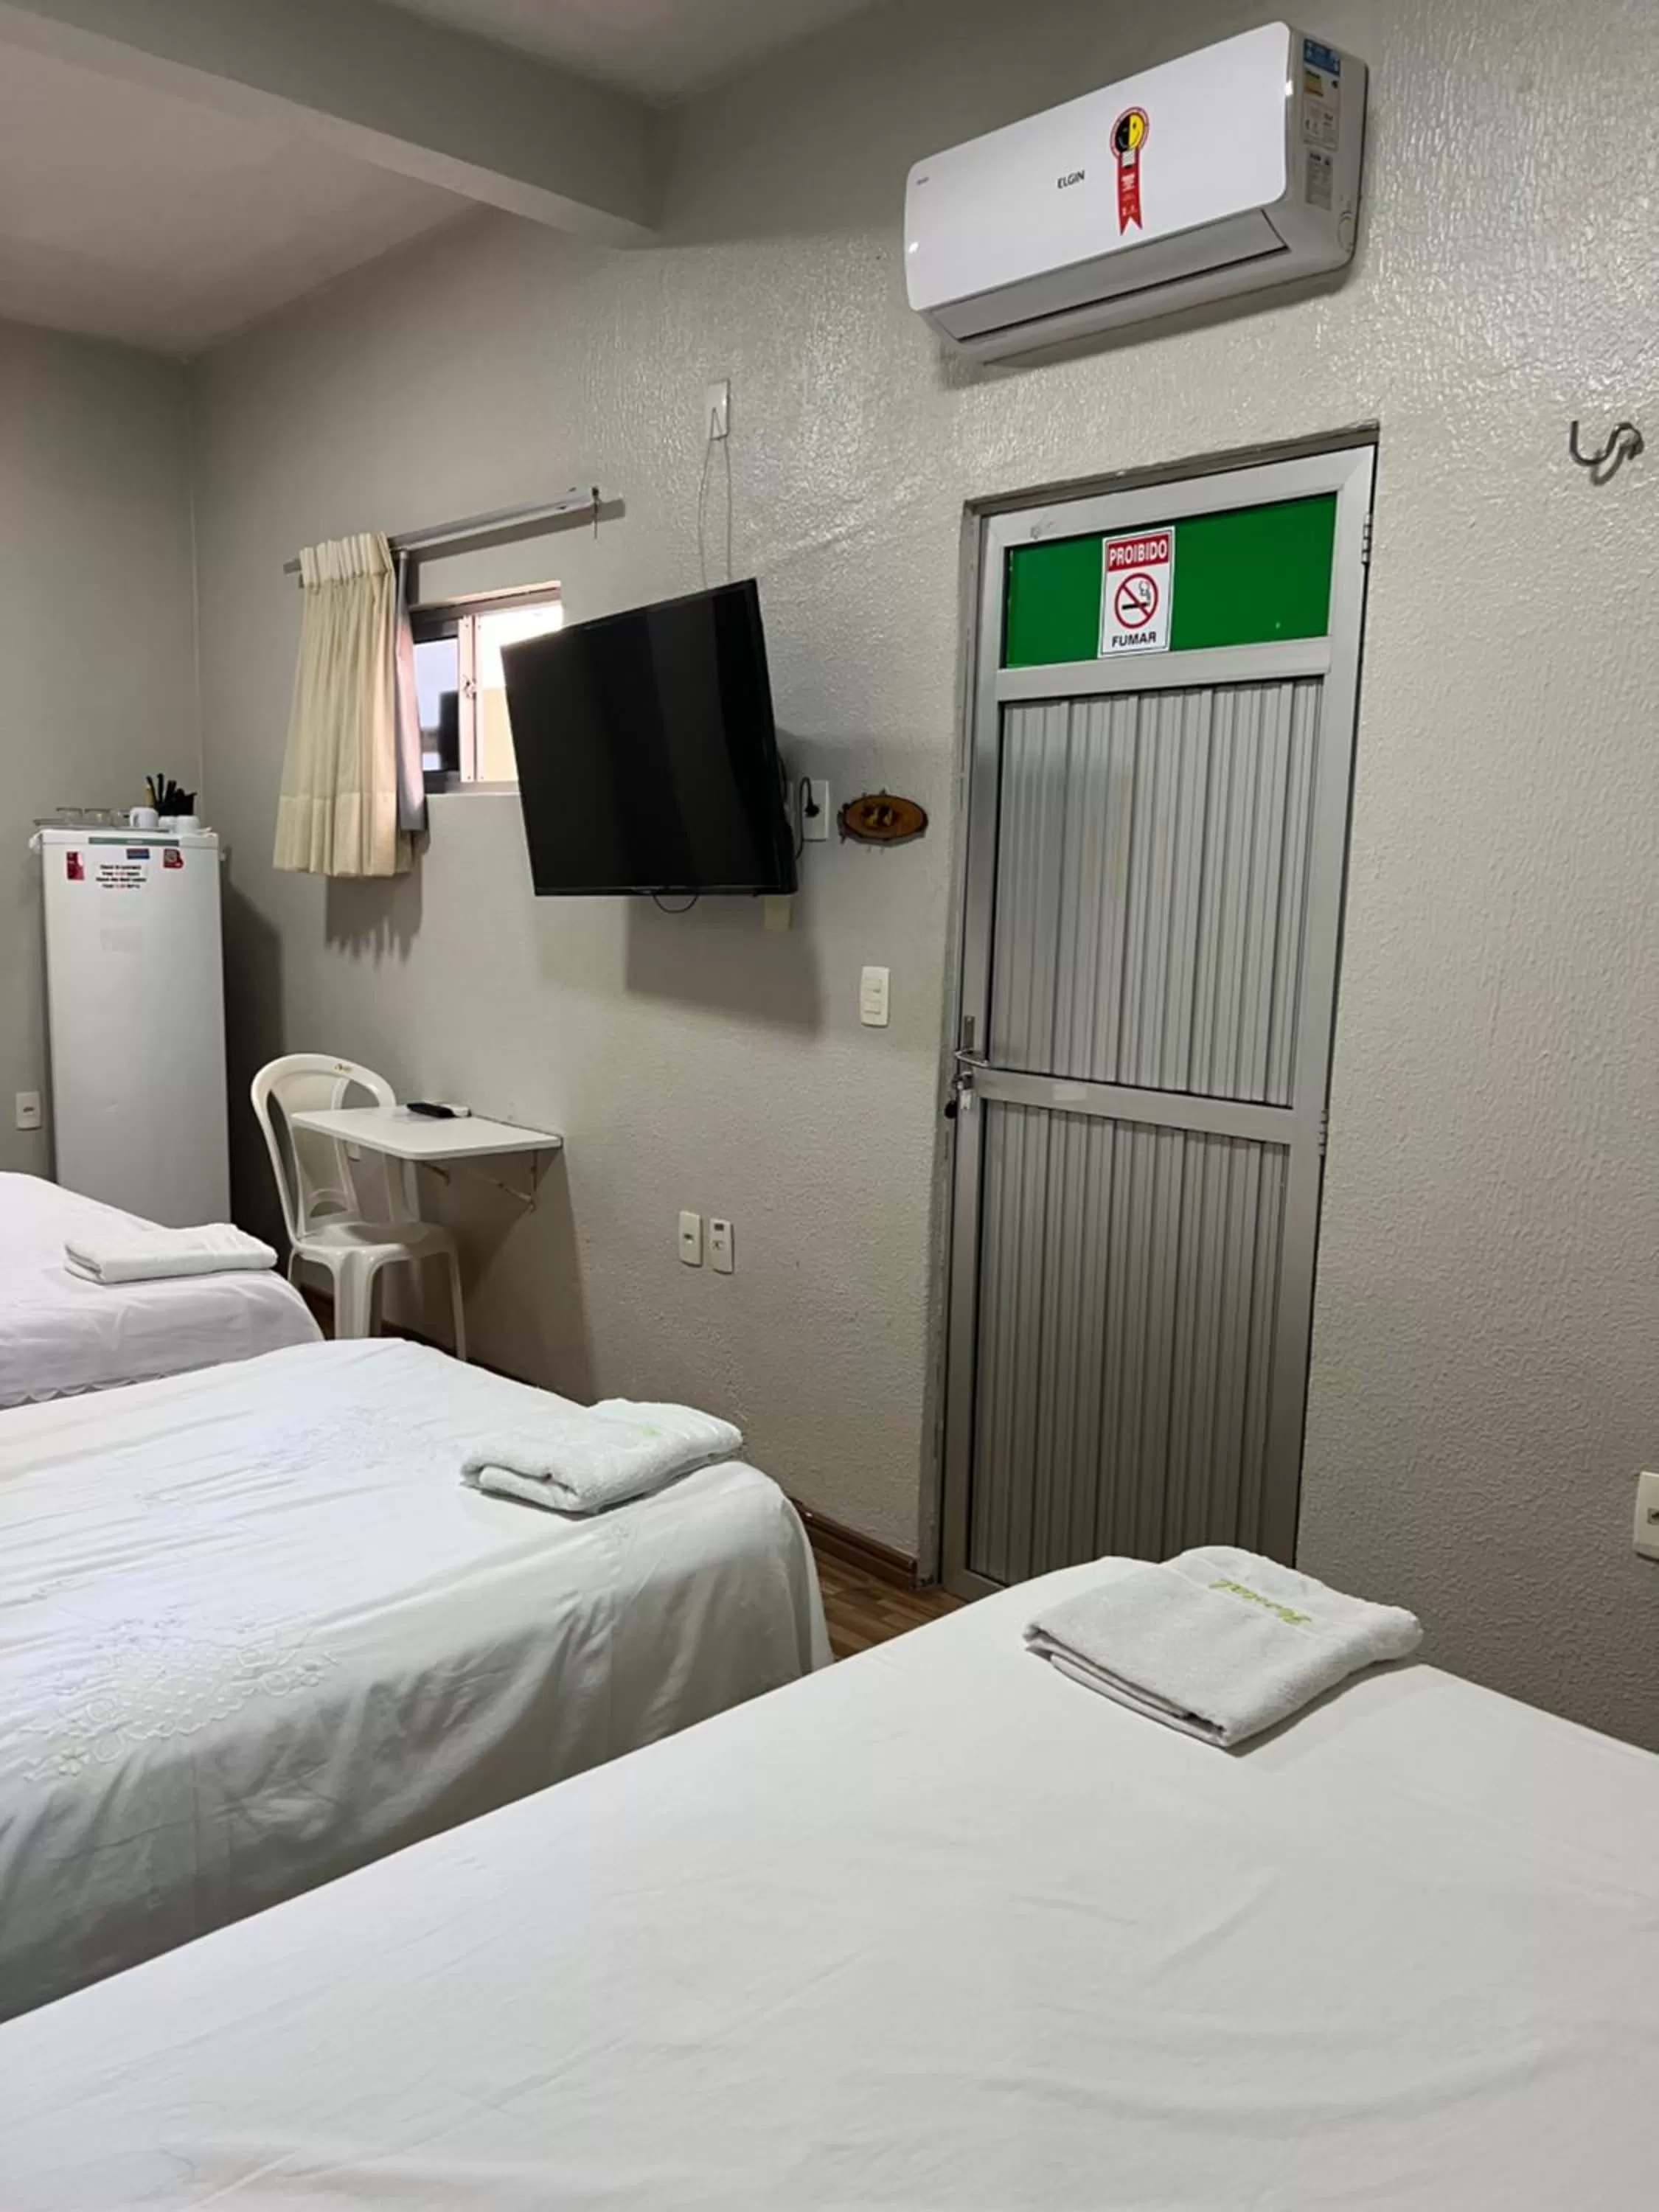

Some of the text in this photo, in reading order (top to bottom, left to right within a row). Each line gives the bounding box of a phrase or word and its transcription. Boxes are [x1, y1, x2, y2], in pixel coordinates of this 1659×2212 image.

[1057, 169, 1086, 189] ELGIN
[1109, 539, 1167, 566] PROIBIDO
[1111, 631, 1158, 647] FUMAR
